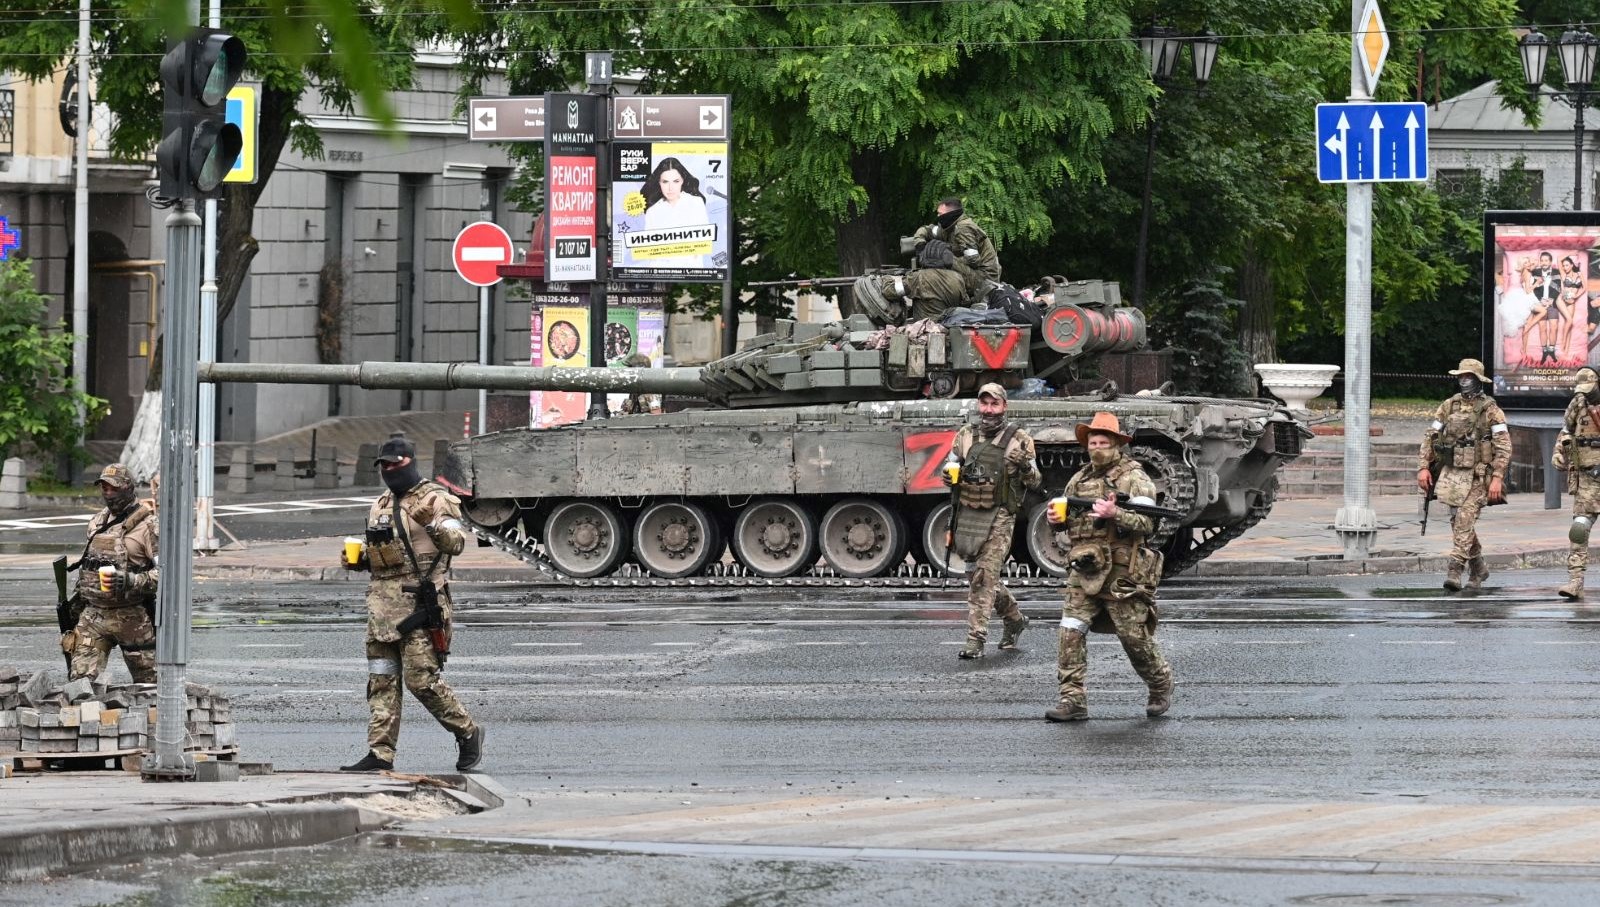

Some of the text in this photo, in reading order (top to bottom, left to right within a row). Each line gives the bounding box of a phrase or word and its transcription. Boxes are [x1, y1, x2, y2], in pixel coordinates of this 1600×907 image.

[552, 133, 594, 143] MANHATTAN
[708, 160, 721, 173] 7
[552, 166, 594, 186] РЕМОНТ
[552, 191, 594, 211] КВАРТИР
[631, 229, 711, 244] ИНФИНИТИ
[559, 242, 587, 255] 2 107 167
[970, 328, 1020, 369] V
[905, 430, 958, 491] Z
